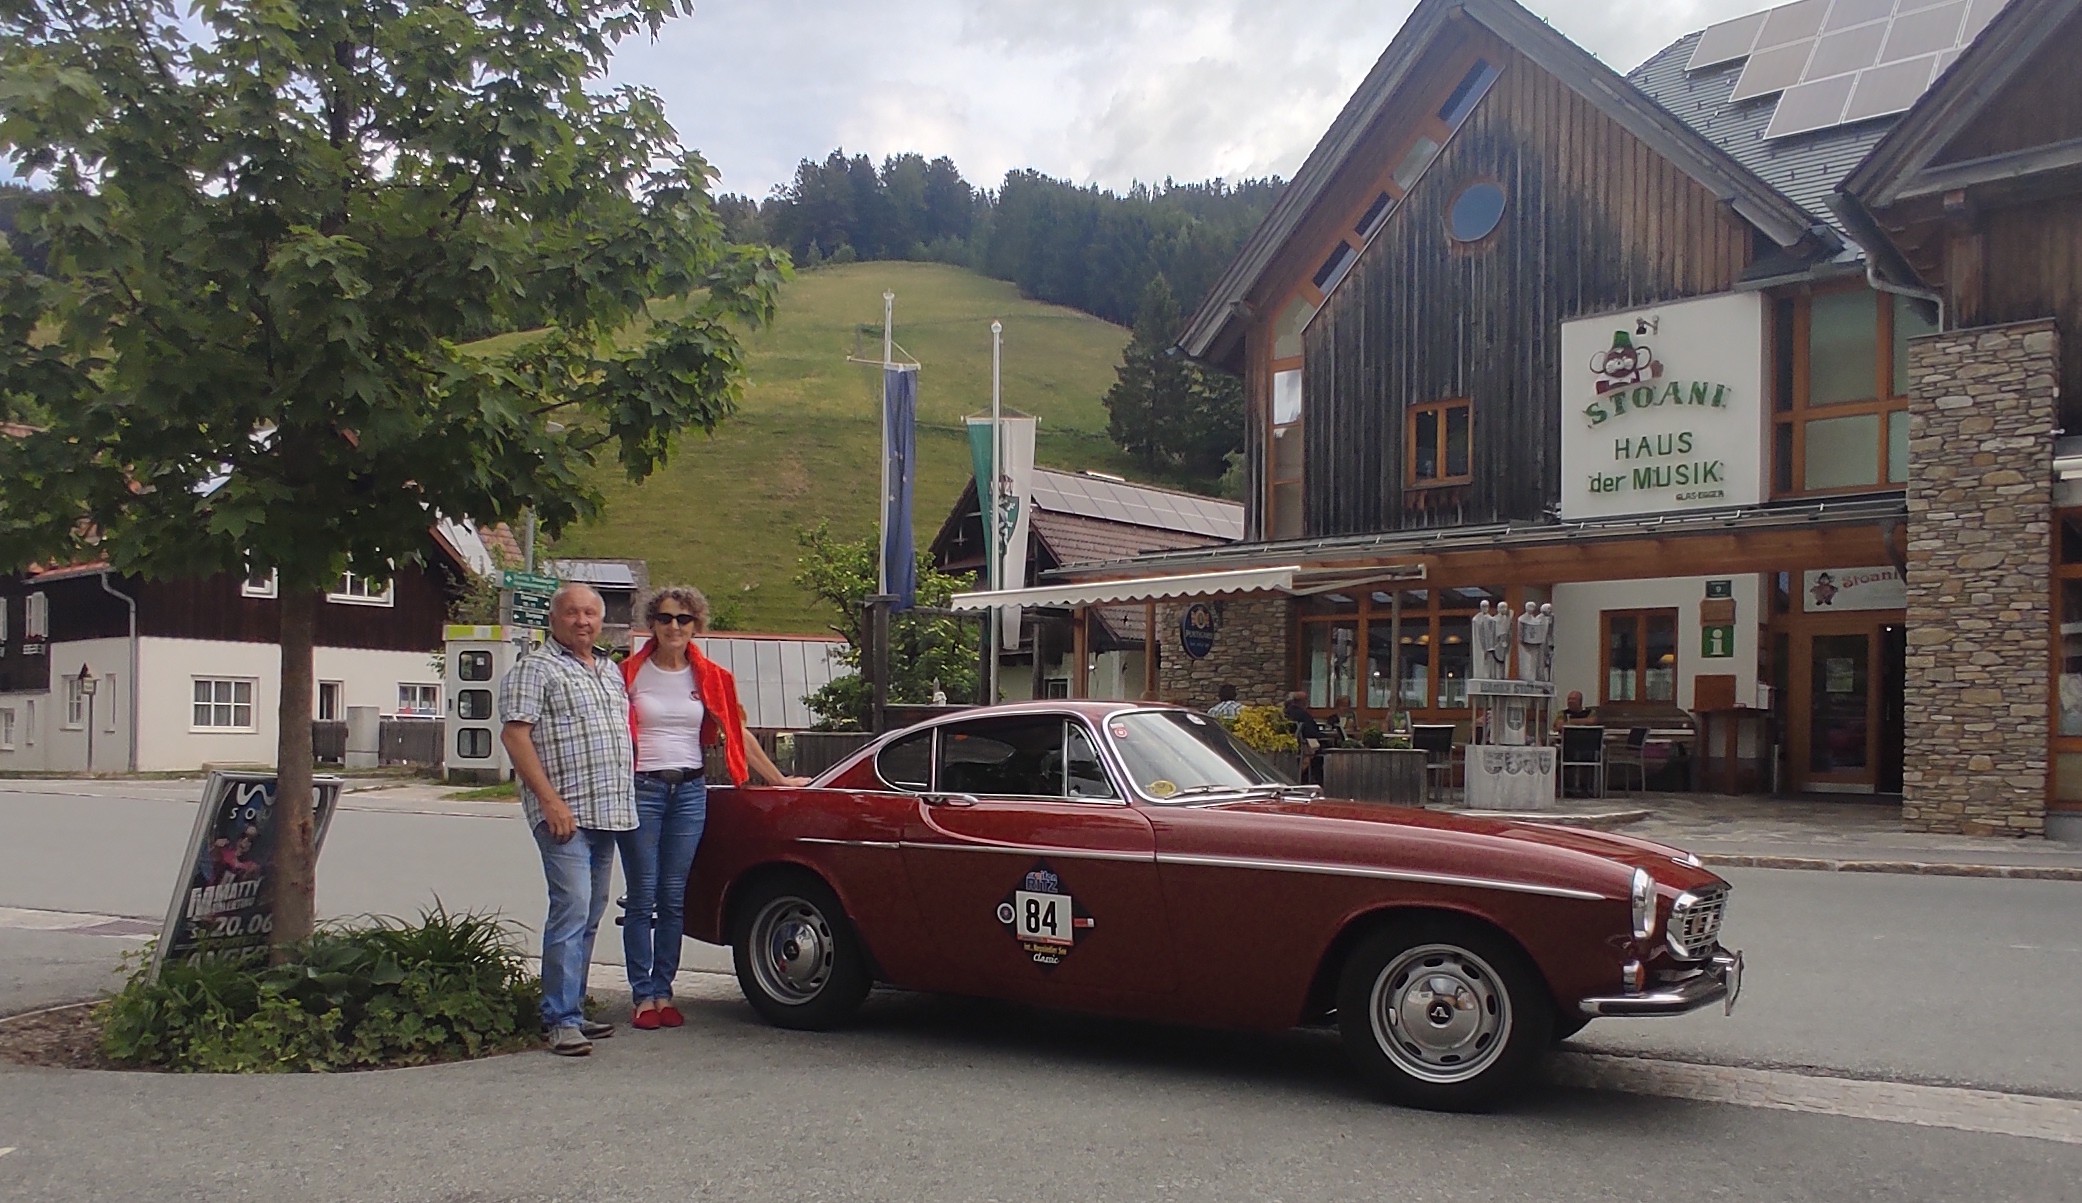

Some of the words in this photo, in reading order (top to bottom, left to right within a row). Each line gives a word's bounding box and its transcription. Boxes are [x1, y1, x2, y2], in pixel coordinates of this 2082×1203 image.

[1583, 381, 1731, 428] STOANI
[1615, 431, 1693, 460] HAUS
[1589, 472, 1627, 493] der
[1632, 460, 1725, 490] MUSIK
[214, 877, 263, 902] MATTY
[1026, 878, 1058, 893] RITZ
[1025, 898, 1057, 936] 84
